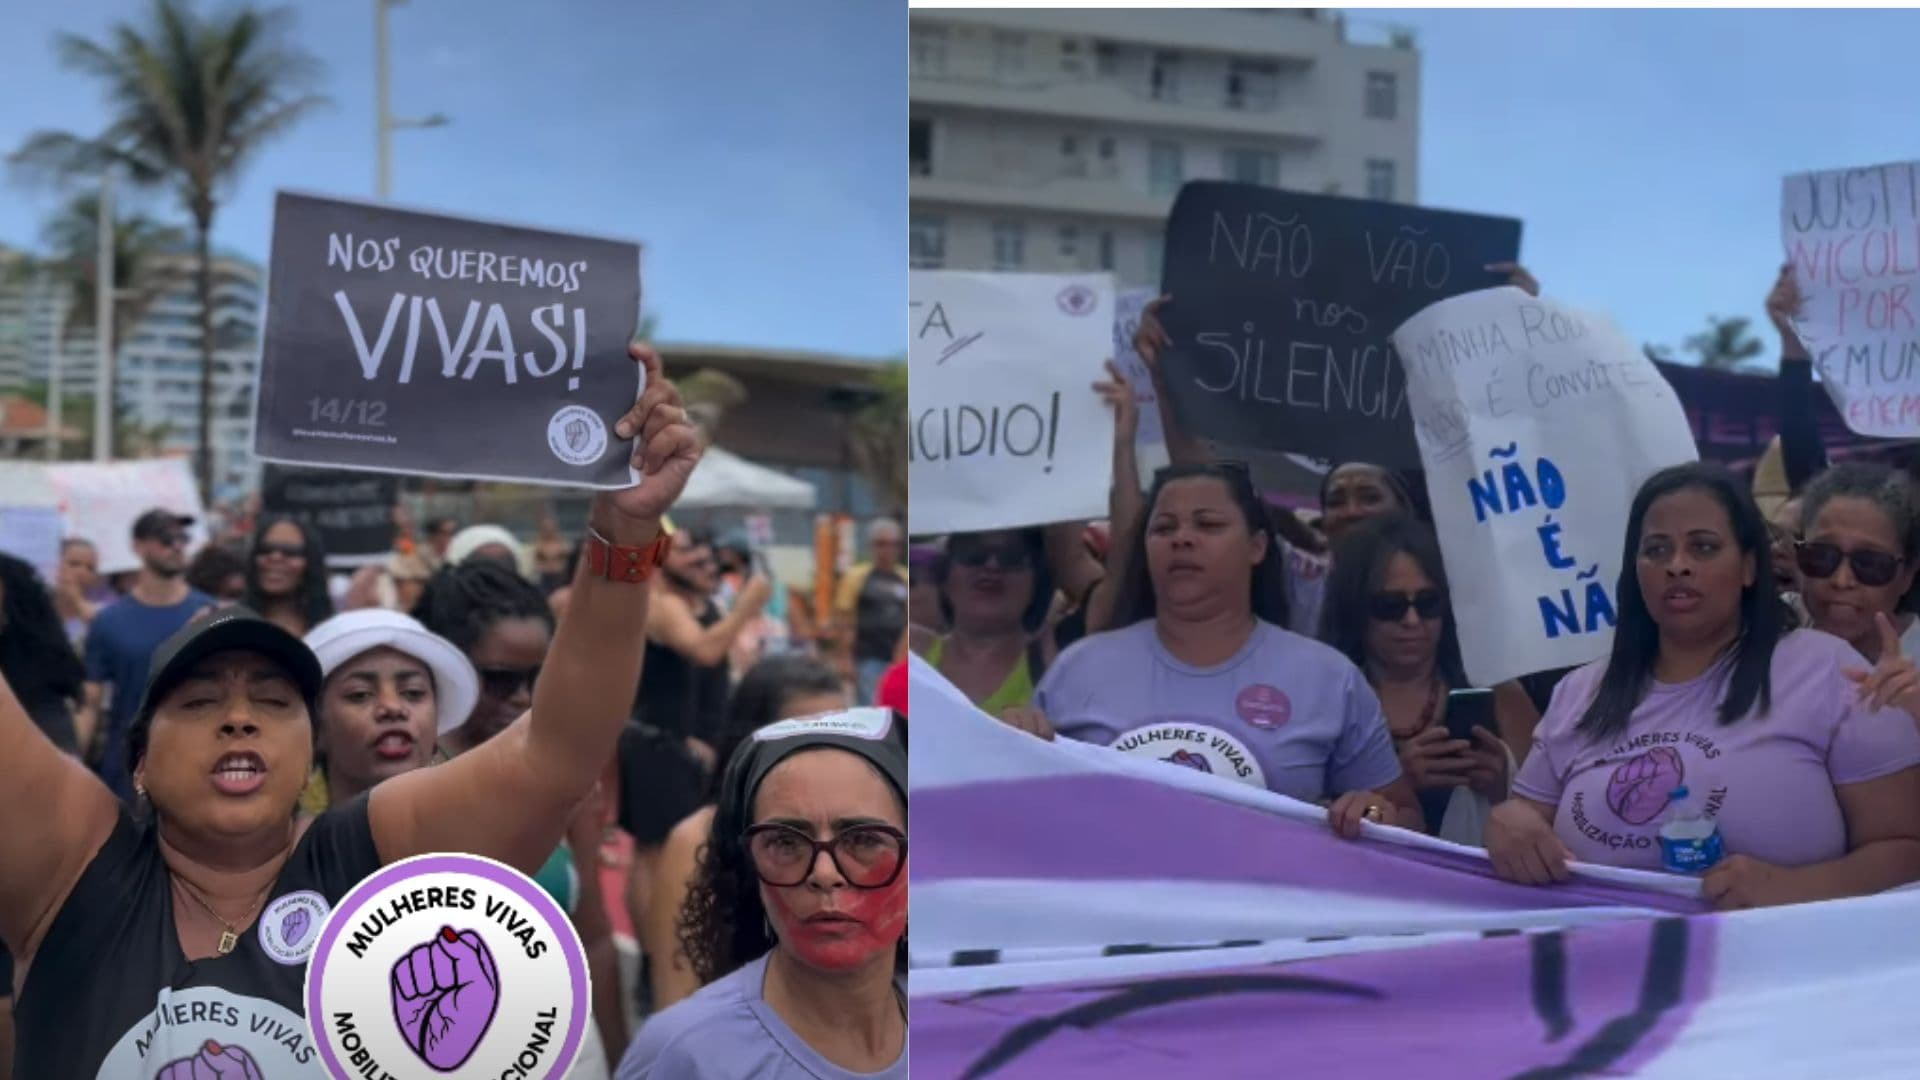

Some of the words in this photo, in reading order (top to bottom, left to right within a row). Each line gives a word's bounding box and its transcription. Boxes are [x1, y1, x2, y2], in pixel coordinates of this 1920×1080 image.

[1792, 167, 1920, 233] JUSTI
[327, 232, 400, 273] NOS
[409, 245, 587, 293] QUEREMOS
[1209, 210, 1312, 280] NÃO
[1365, 225, 1450, 290] VÃO
[1788, 226, 1920, 288] NICOL
[334, 289, 587, 392] VIVAS!
[1294, 296, 1368, 334] nos
[1838, 284, 1915, 337] POR
[306, 397, 387, 427] 14/12
[1467, 441, 1567, 524] NÃO
[1537, 513, 1576, 570] É
[1538, 563, 1617, 639] NÃ
[1211, 736, 1253, 778] VIVAS
[249, 1013, 317, 1065] VIVAS
